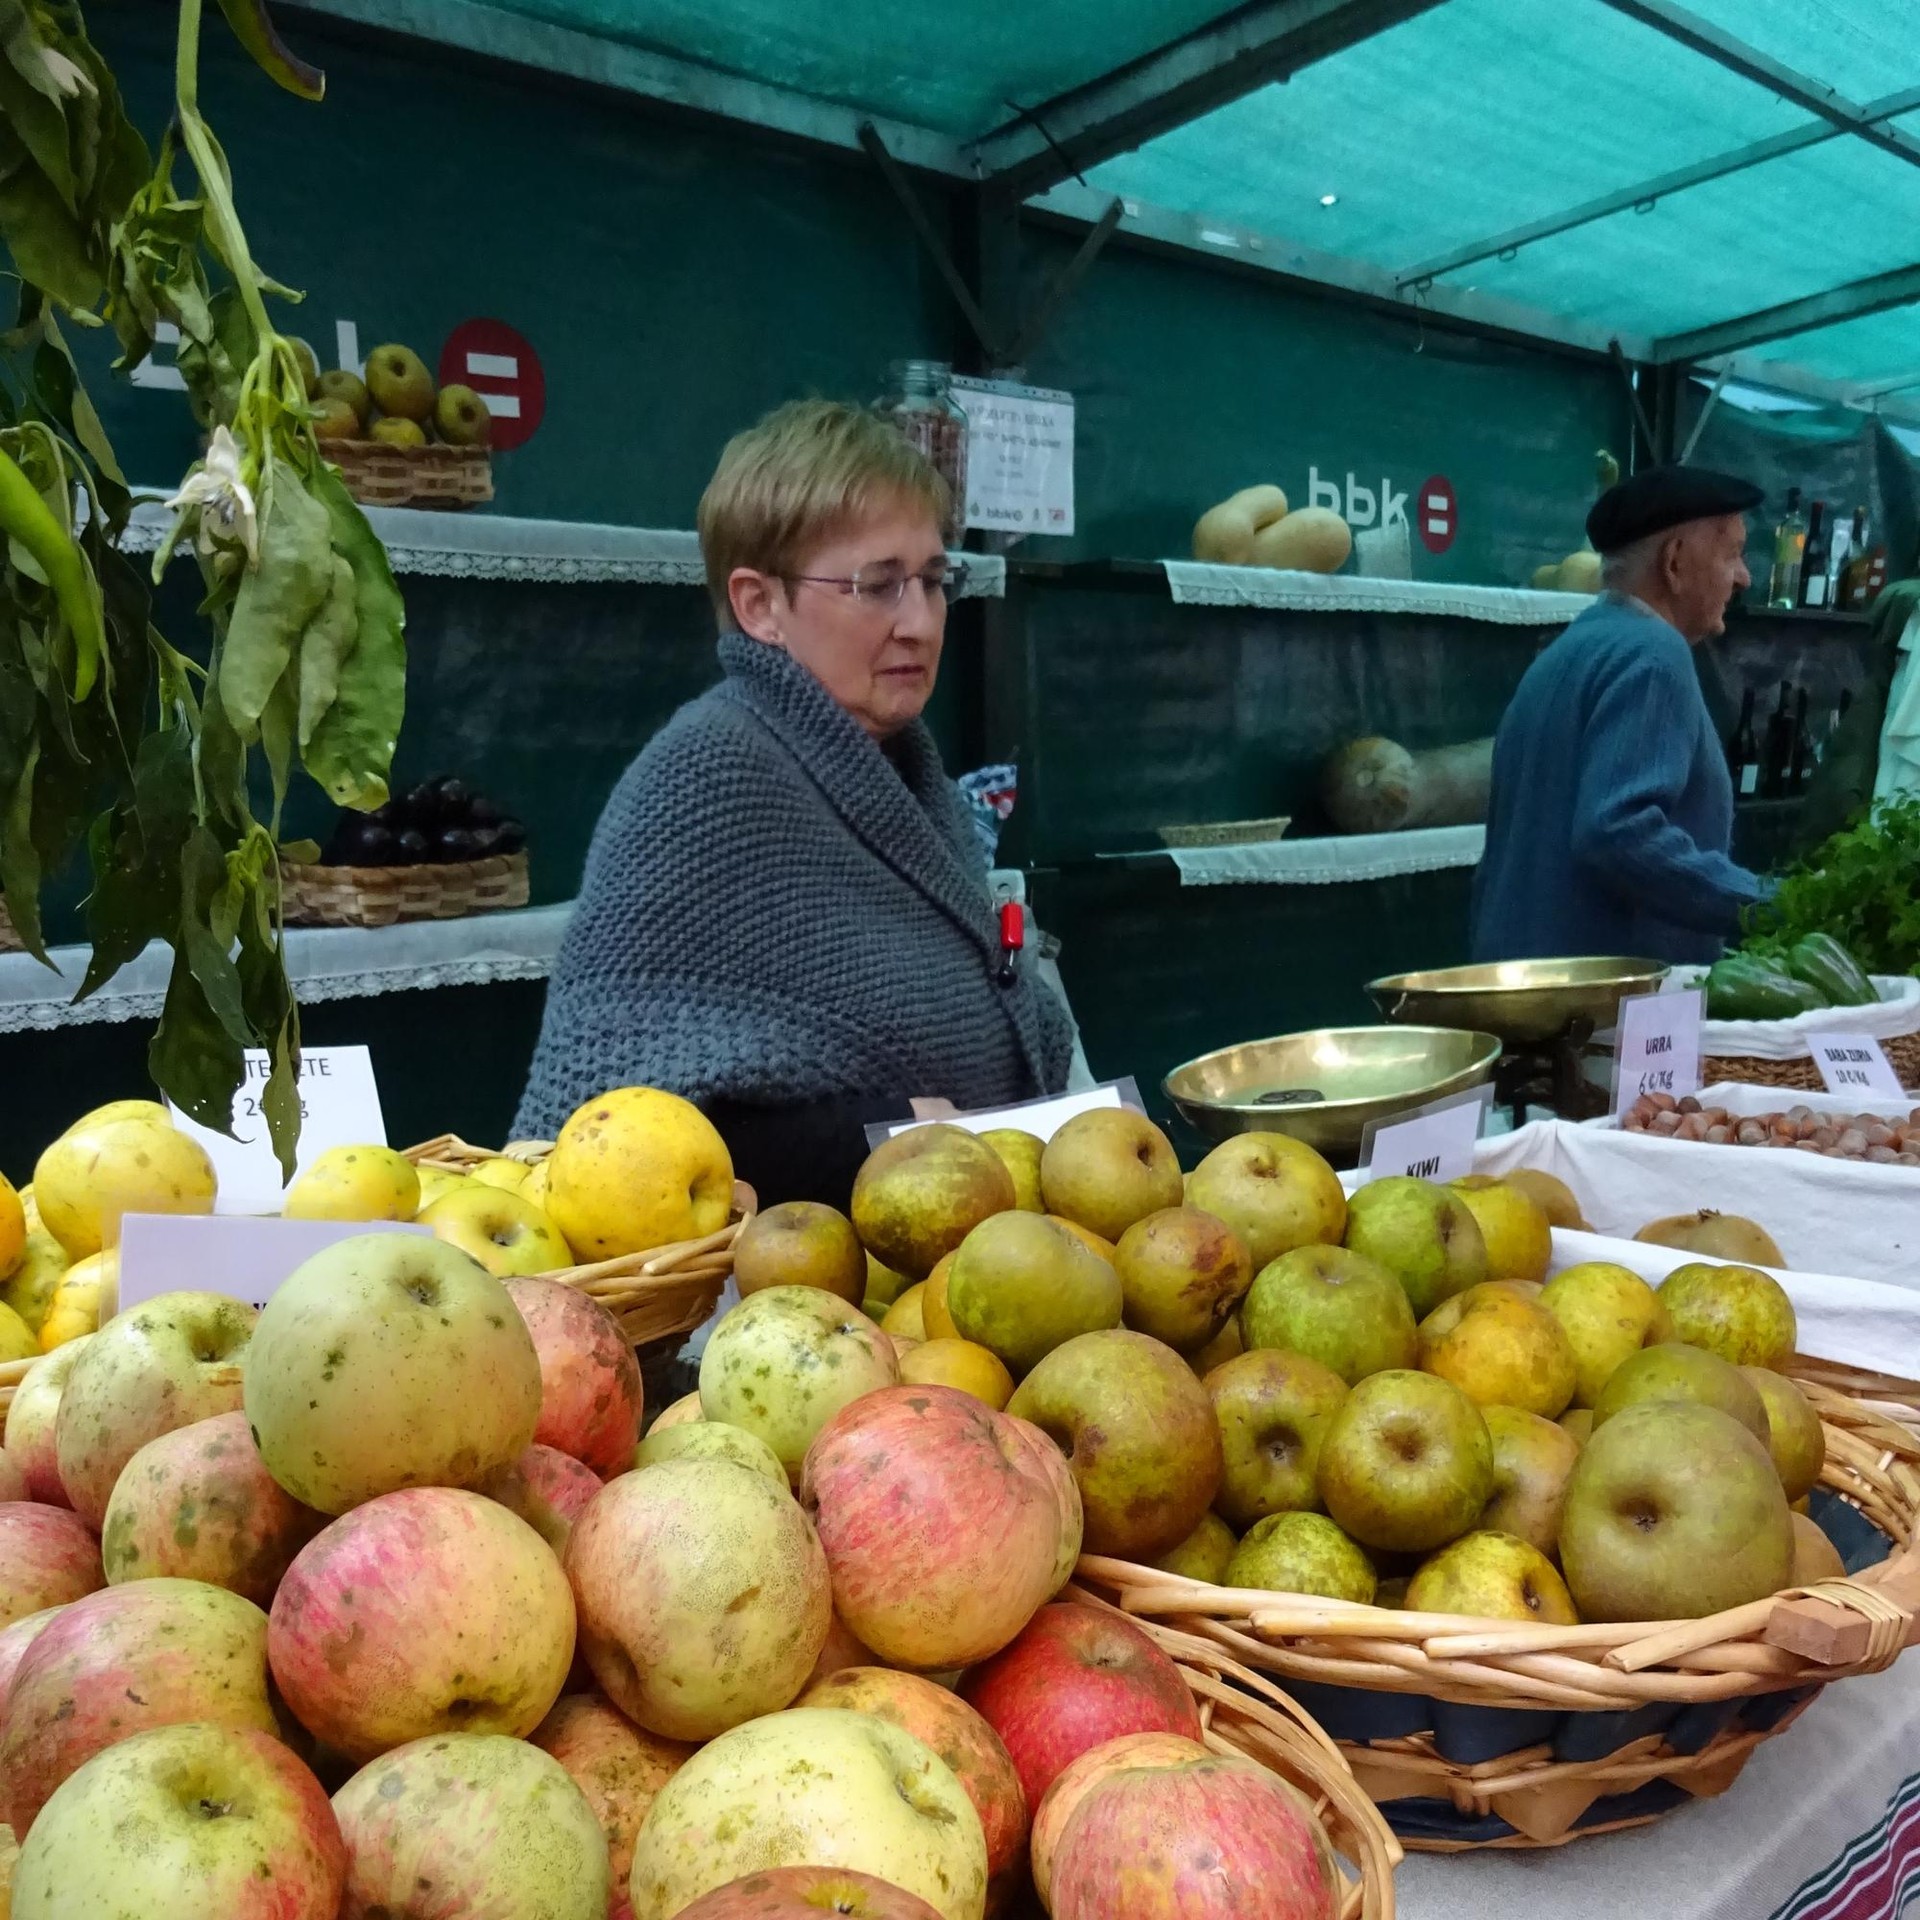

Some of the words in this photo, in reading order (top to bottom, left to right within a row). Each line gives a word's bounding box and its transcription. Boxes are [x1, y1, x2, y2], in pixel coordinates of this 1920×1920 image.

[1308, 466, 1409, 527] bbk
[1645, 1034, 1672, 1055] URRA
[1406, 1156, 1440, 1178] KIWI
